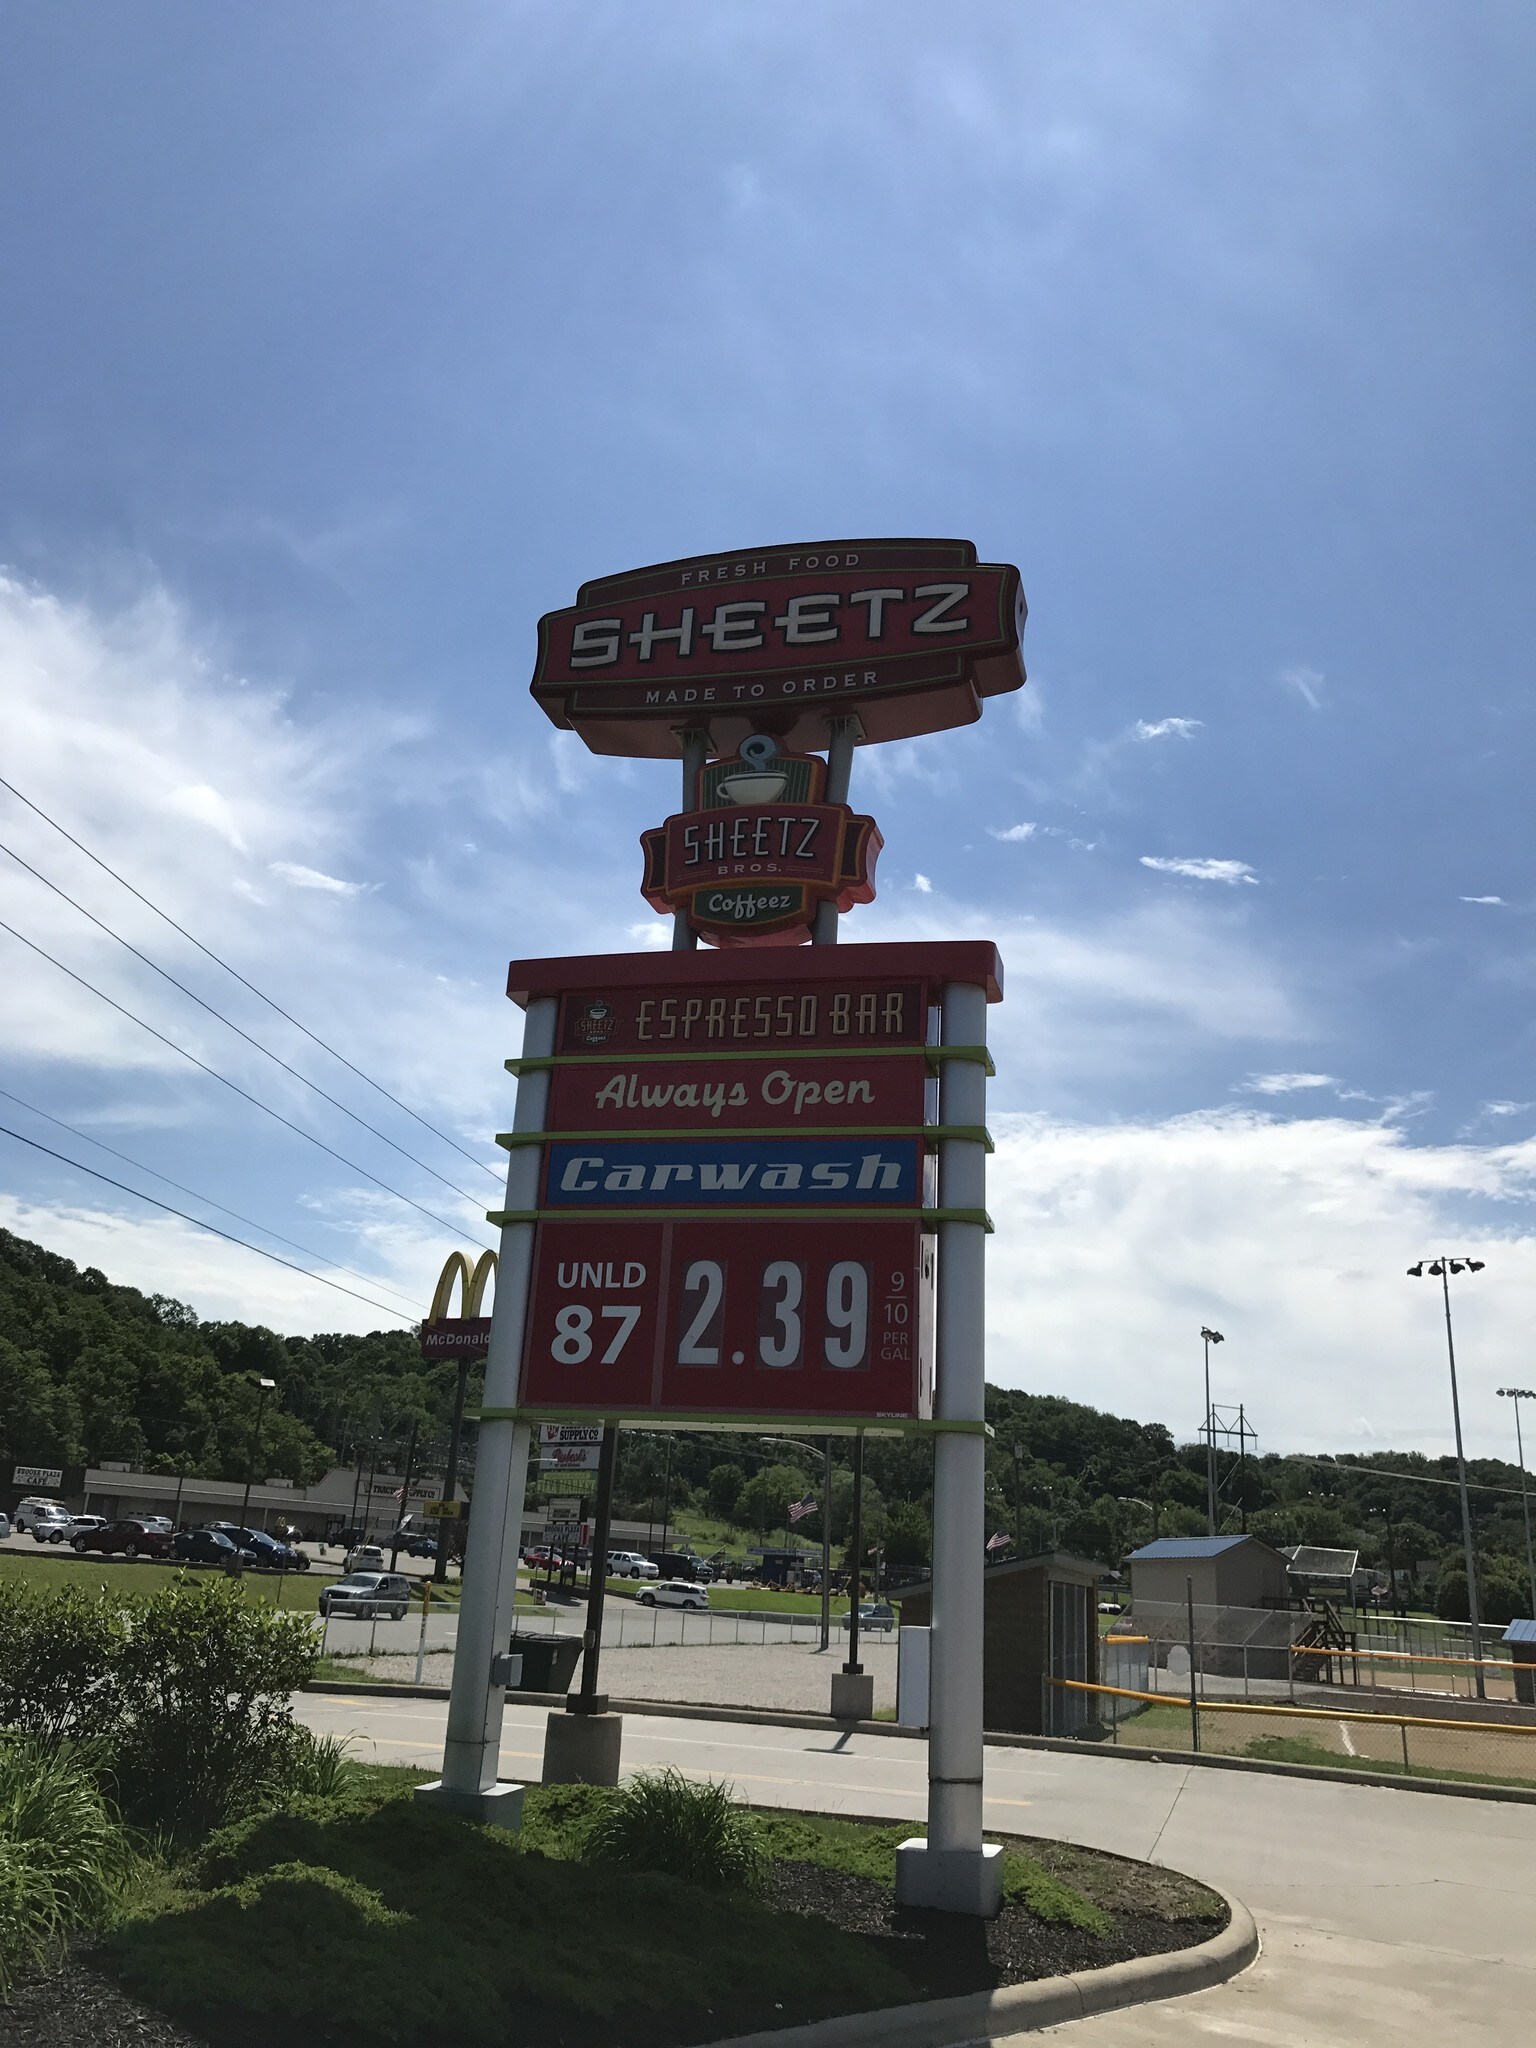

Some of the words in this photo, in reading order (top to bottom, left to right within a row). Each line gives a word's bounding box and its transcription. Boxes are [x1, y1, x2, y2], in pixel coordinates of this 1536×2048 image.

[681, 561, 768, 585] FRESH
[788, 553, 860, 572] FOOD
[569, 583, 970, 668] SHEETZ
[645, 688, 717, 704] MADE
[733, 683, 765, 699] TO
[782, 671, 879, 694] ORDER
[684, 817, 820, 865] SHEETZ
[717, 863, 782, 875] BROS.
[708, 893, 791, 919] Coffeez
[580, 1019, 615, 1032] SHEETZ
[635, 995, 818, 1041] ESPRESSO
[828, 992, 904, 1035] BAR
[595, 1073, 749, 1118] Always
[761, 1069, 876, 1114] Open
[559, 1153, 902, 1192] Carwash
[557, 1262, 647, 1289] UNLD
[890, 1271, 905, 1292] 9
[677, 1259, 869, 1368] 2.39
[883, 1302, 909, 1324] 10
[550, 1305, 642, 1365] 87
[882, 1332, 909, 1345] PER
[880, 1346, 911, 1361] GAL
[559, 1430, 588, 1441] SUPPLY
[27, 1476, 47, 1486] CAFE
